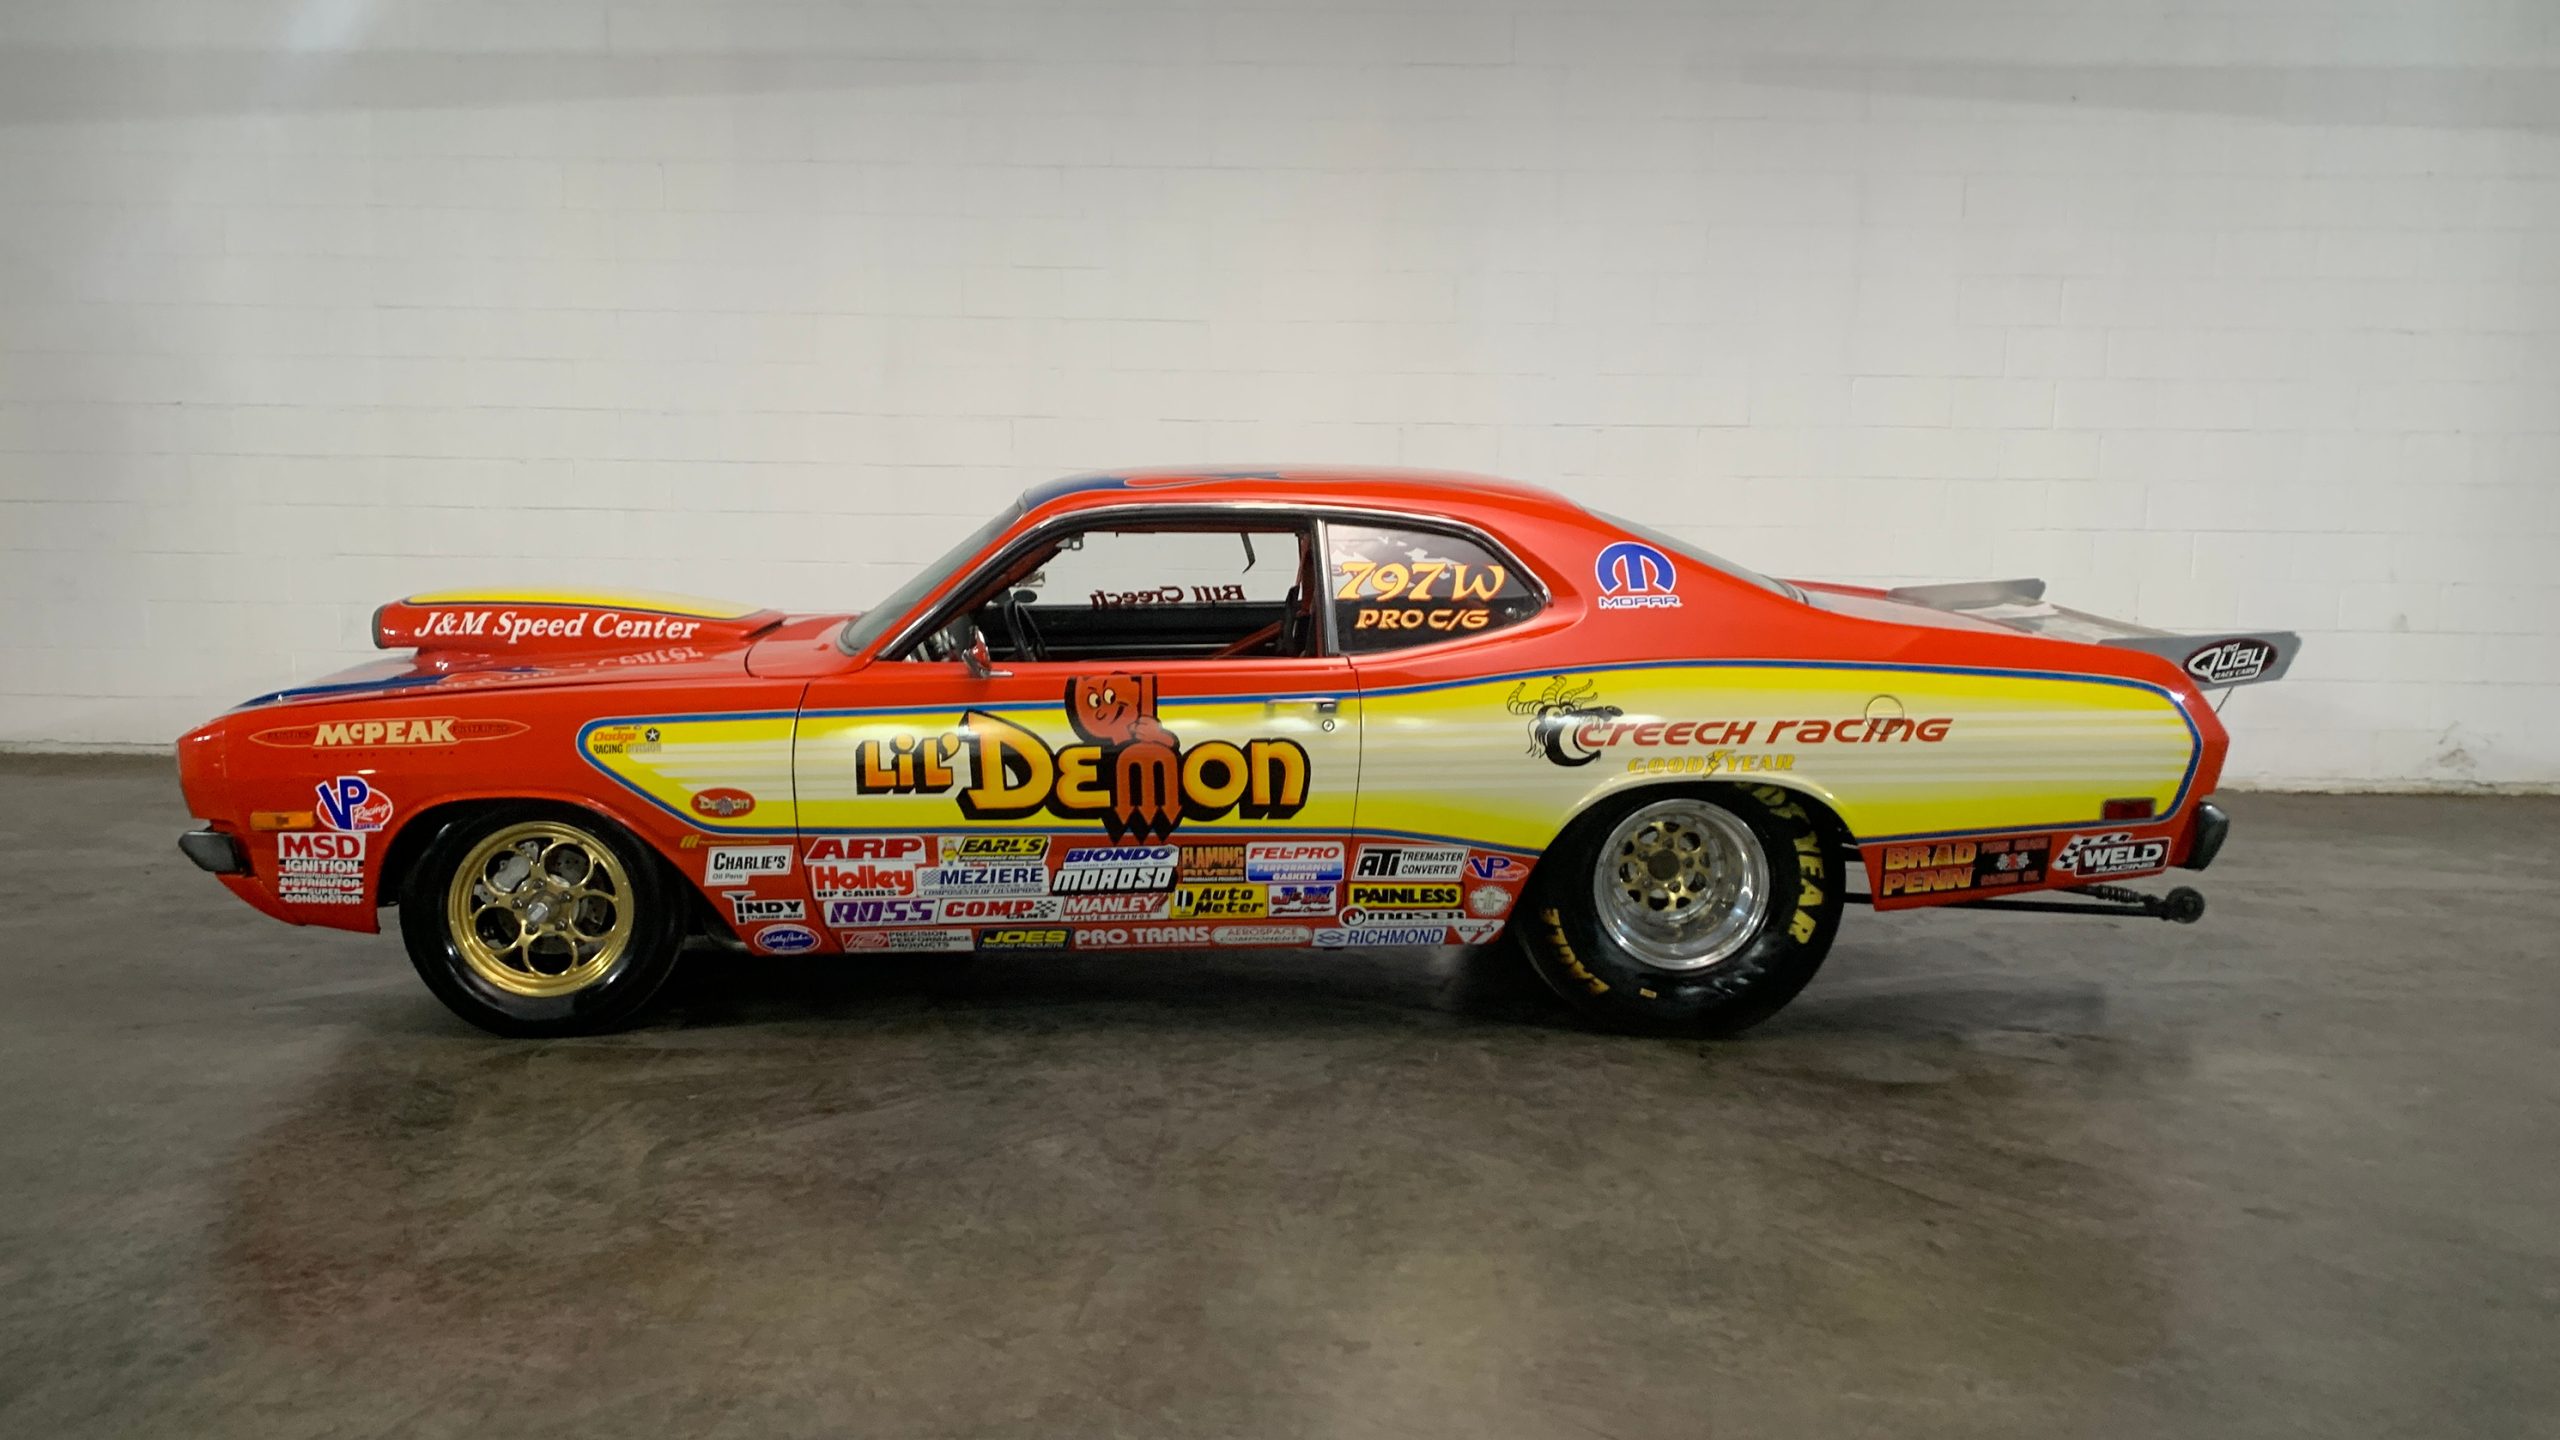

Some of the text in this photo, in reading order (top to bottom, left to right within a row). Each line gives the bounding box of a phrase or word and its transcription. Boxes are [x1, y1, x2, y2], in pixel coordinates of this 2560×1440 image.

[1600, 596, 1679, 608] MOPAR
[414, 611, 700, 644] J&M Speed Center
[1354, 609, 1490, 631] PRO C/G
[2188, 646, 2269, 684] Quay
[313, 718, 458, 746] McPEAK
[594, 731, 637, 744] Dodge
[593, 743, 624, 754] RACING
[316, 776, 369, 831] VP
[354, 804, 388, 823] Racing
[283, 835, 361, 859] MSD
[807, 838, 922, 859] ARP
[961, 838, 1043, 853] EARL'S
[713, 852, 786, 870] CHARLIE'S
[1064, 848, 1172, 862] BIONDO
[1182, 846, 1244, 867] FLAMING
[1357, 848, 1402, 876] ATI
[1402, 851, 1464, 861] TREEMASTER
[1885, 843, 1977, 870] BRAD
[2085, 843, 2163, 867] WELD
[285, 859, 359, 872] IGNITION
[1183, 868, 1243, 877] RIVER
[1256, 863, 1332, 872] PERFORMANCE
[1401, 864, 1458, 875] CONVERTER
[1470, 857, 1511, 879] VP
[2096, 861, 2155, 873] RACING
[280, 877, 361, 887] DISTRIBUTOR
[815, 865, 914, 896] Holley
[940, 867, 1044, 884] MEZIERE
[1052, 866, 1173, 891] MOROSO
[1271, 872, 1318, 881] GASKETS
[1883, 867, 1974, 895] PENN
[285, 894, 361, 905] CONDUCTOR
[817, 889, 897, 898] HP CARBS
[1199, 888, 1254, 901] Auto
[1353, 888, 1457, 904] PAINLESS
[723, 891, 802, 923] INDY
[830, 900, 936, 923] ROSS
[945, 900, 1035, 918] COMP
[1066, 895, 1160, 913] MANLEY
[1193, 901, 1264, 916] Meter
[1006, 912, 1049, 920] CAMS
[984, 929, 1067, 944] JOES
[1075, 926, 1210, 945] PRO TRANS
[1227, 927, 1297, 936] AEROSPACE
[1348, 928, 1444, 945] RICHMOND
